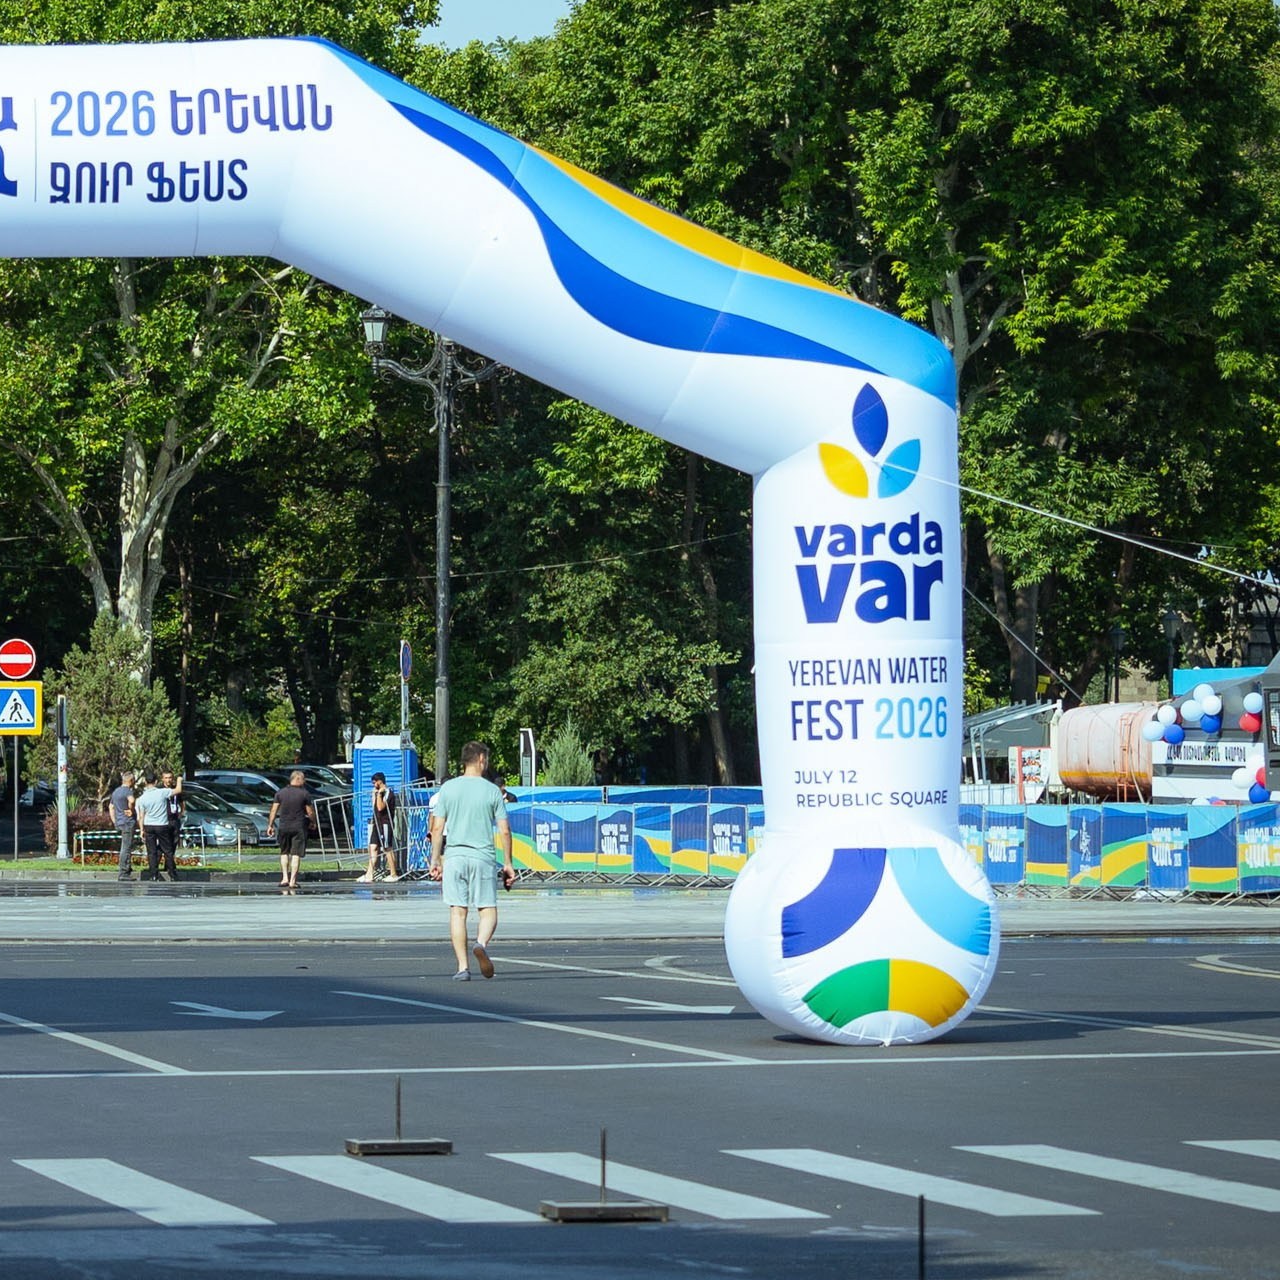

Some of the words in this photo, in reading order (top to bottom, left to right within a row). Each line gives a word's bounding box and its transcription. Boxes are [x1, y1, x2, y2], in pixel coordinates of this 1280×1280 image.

[50, 90, 156, 137] 2026
[169, 84, 333, 136] ԵՐԵՎԱՆ
[50, 161, 133, 204] ՋՈՒՐ
[146, 159, 249, 203] ՖԵՍՏ
[794, 511, 943, 558] varda
[795, 560, 943, 624] var
[788, 658, 881, 687] YEREVAN
[888, 656, 947, 684] WATER
[790, 698, 864, 741] FEST
[875, 696, 947, 739] 2026
[794, 770, 834, 784] JULY
[839, 770, 858, 784] 12
[796, 792, 883, 808] REPUBLIC
[890, 789, 948, 808] SQUARE
